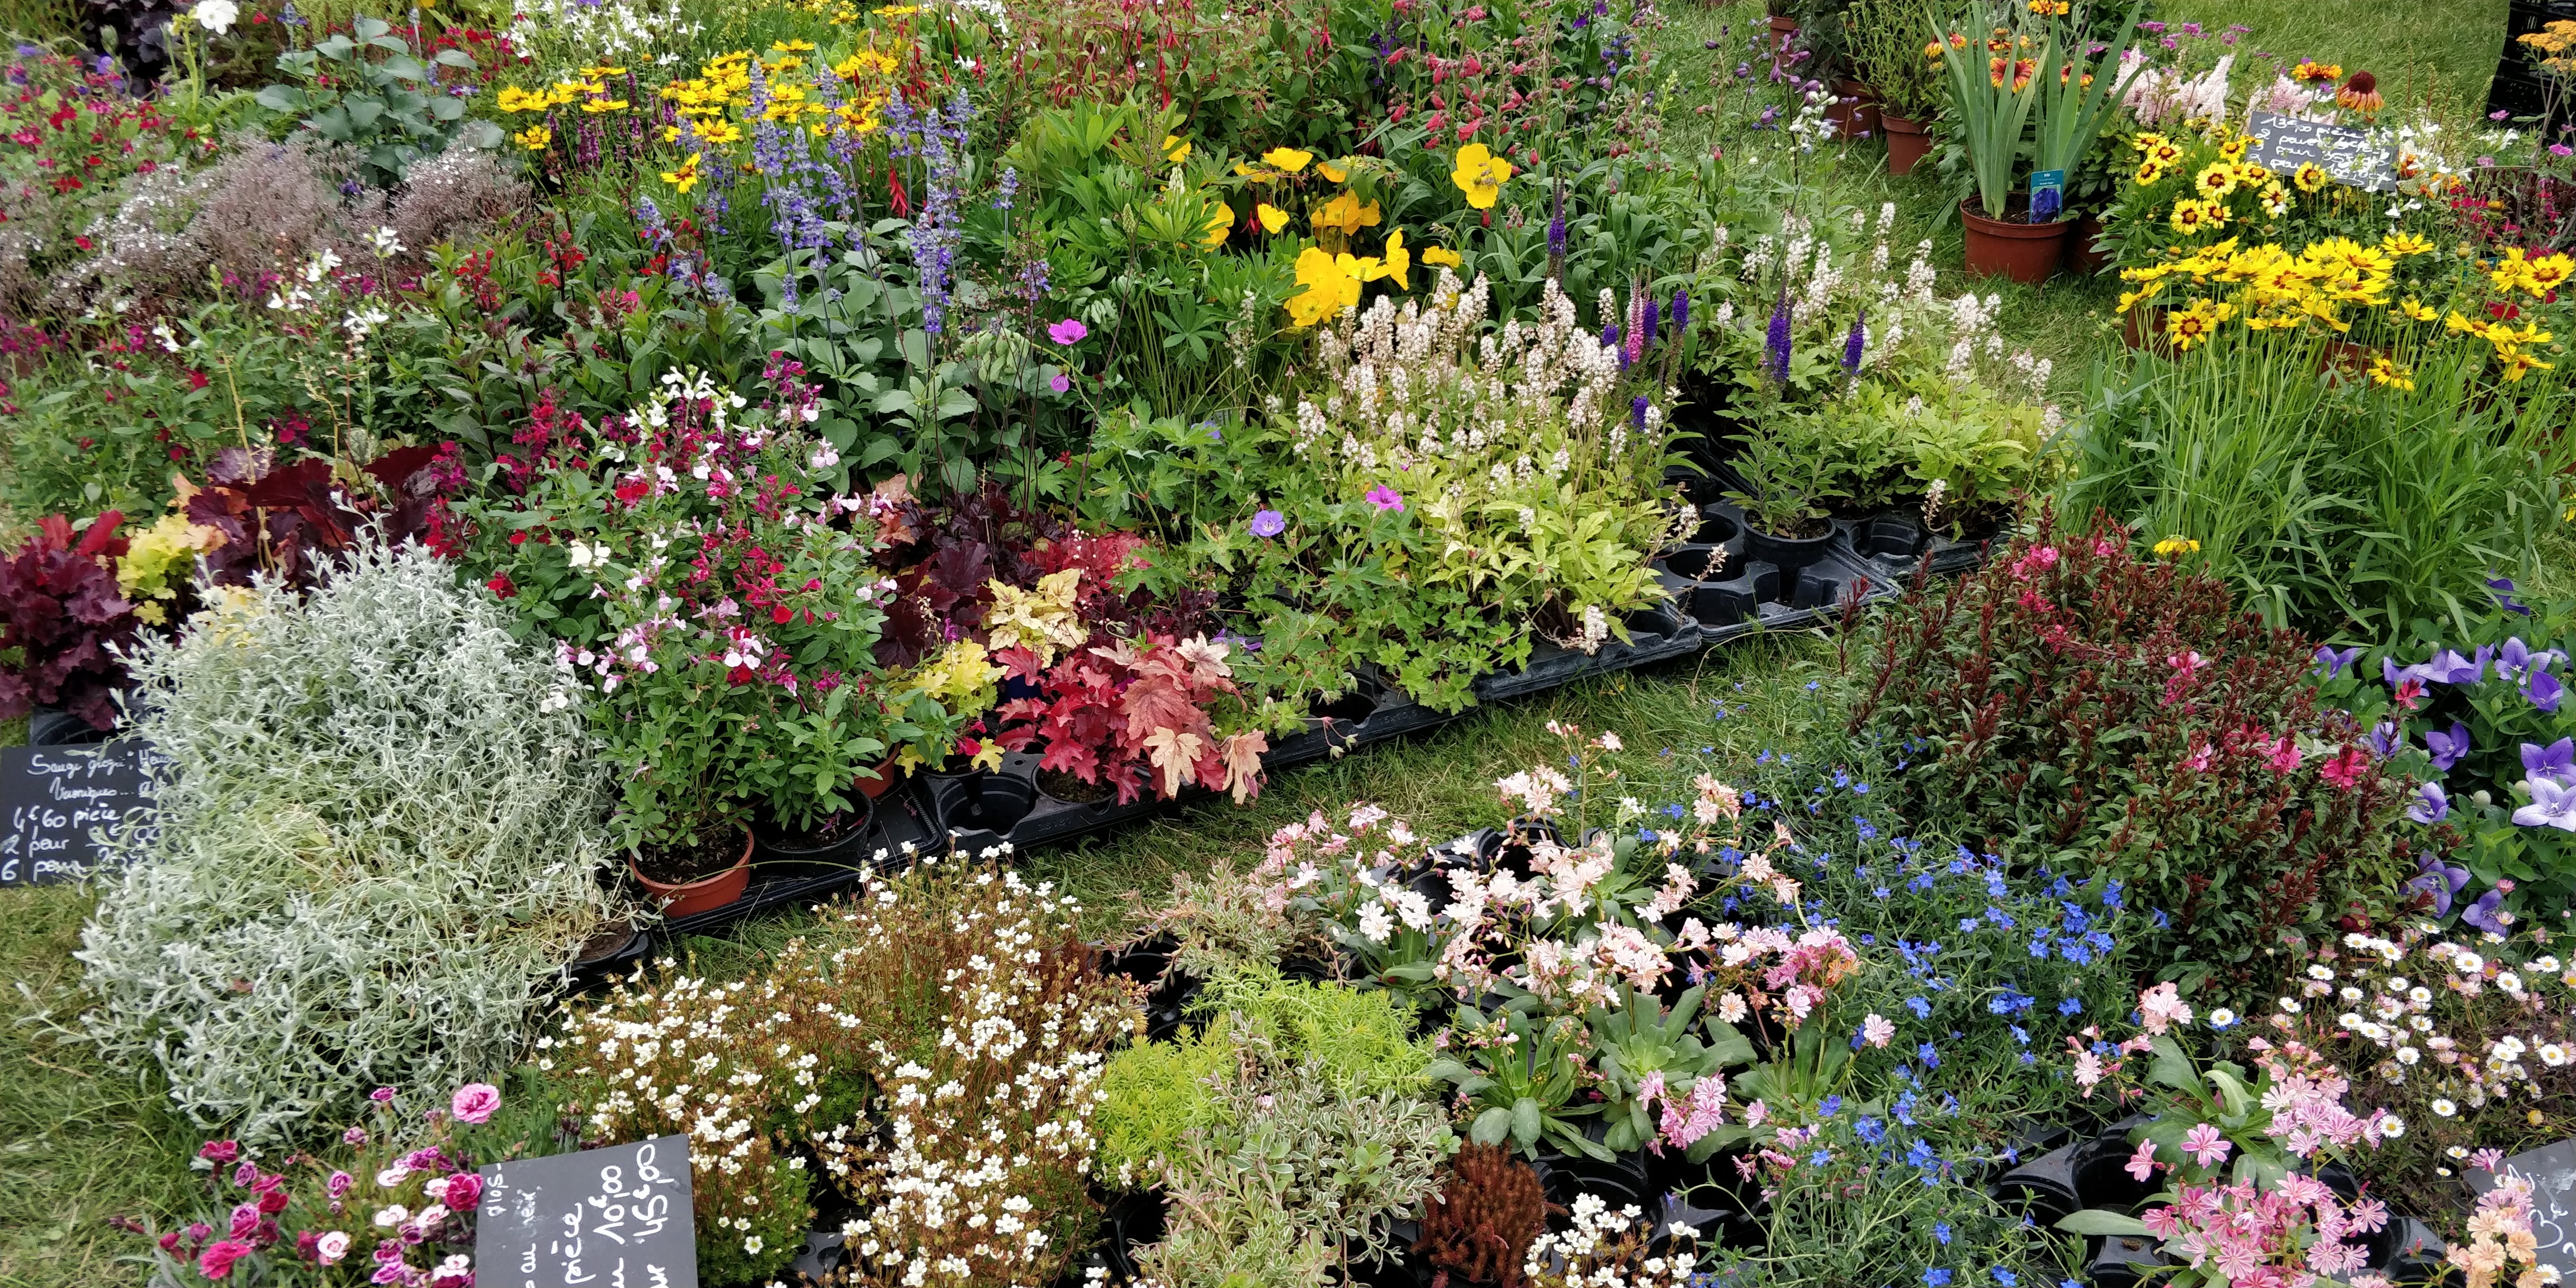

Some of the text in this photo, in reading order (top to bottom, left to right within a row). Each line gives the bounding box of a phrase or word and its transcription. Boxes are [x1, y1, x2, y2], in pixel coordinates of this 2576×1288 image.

[29, 838, 70, 858] pour
[1, 858, 20, 881] 6
[550, 1202, 596, 1285] pièce
